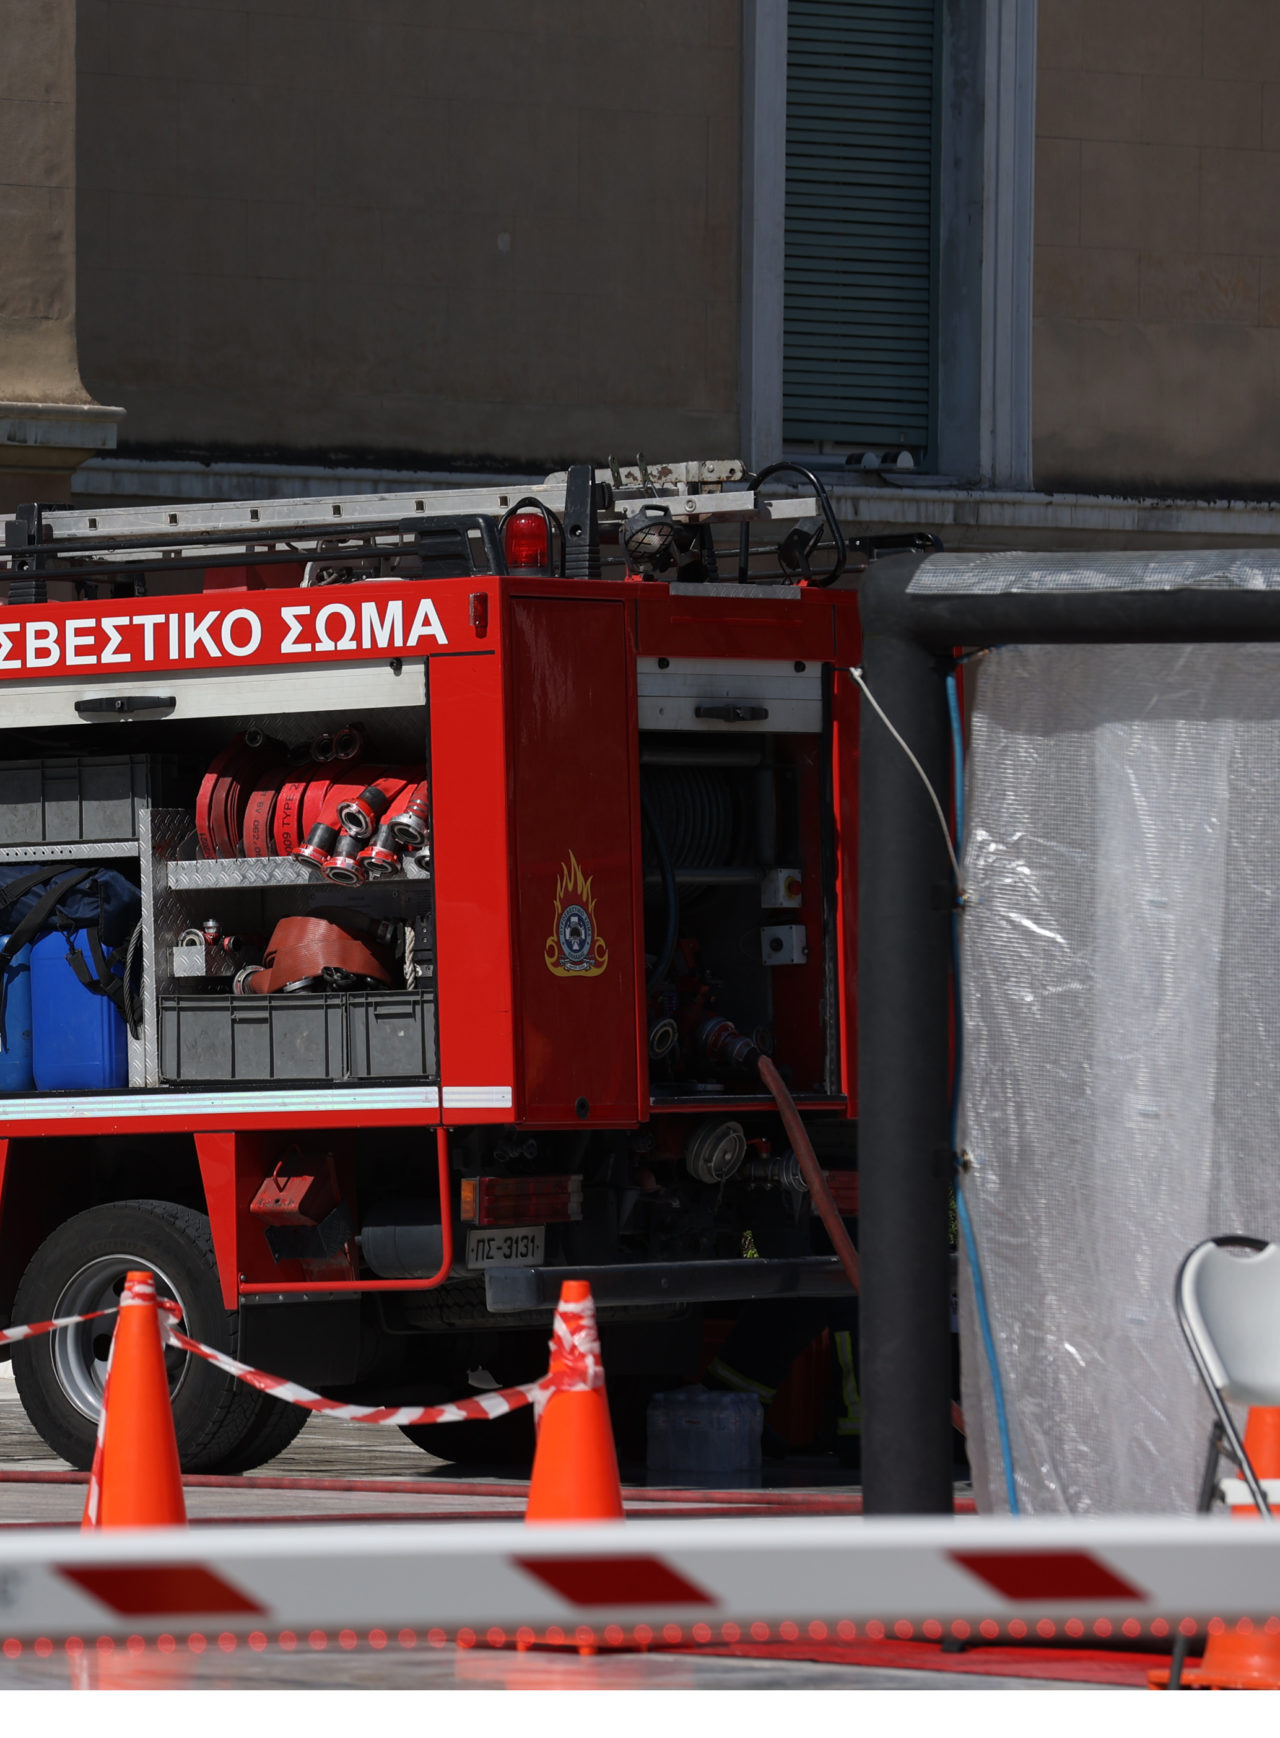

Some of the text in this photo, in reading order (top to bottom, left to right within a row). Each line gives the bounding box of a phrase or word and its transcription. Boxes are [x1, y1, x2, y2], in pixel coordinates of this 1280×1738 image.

[280, 598, 449, 654] ΣΩΜΑ
[282, 795, 295, 828] TYPE
[475, 1234, 536, 1262] ΠΣ-3131
